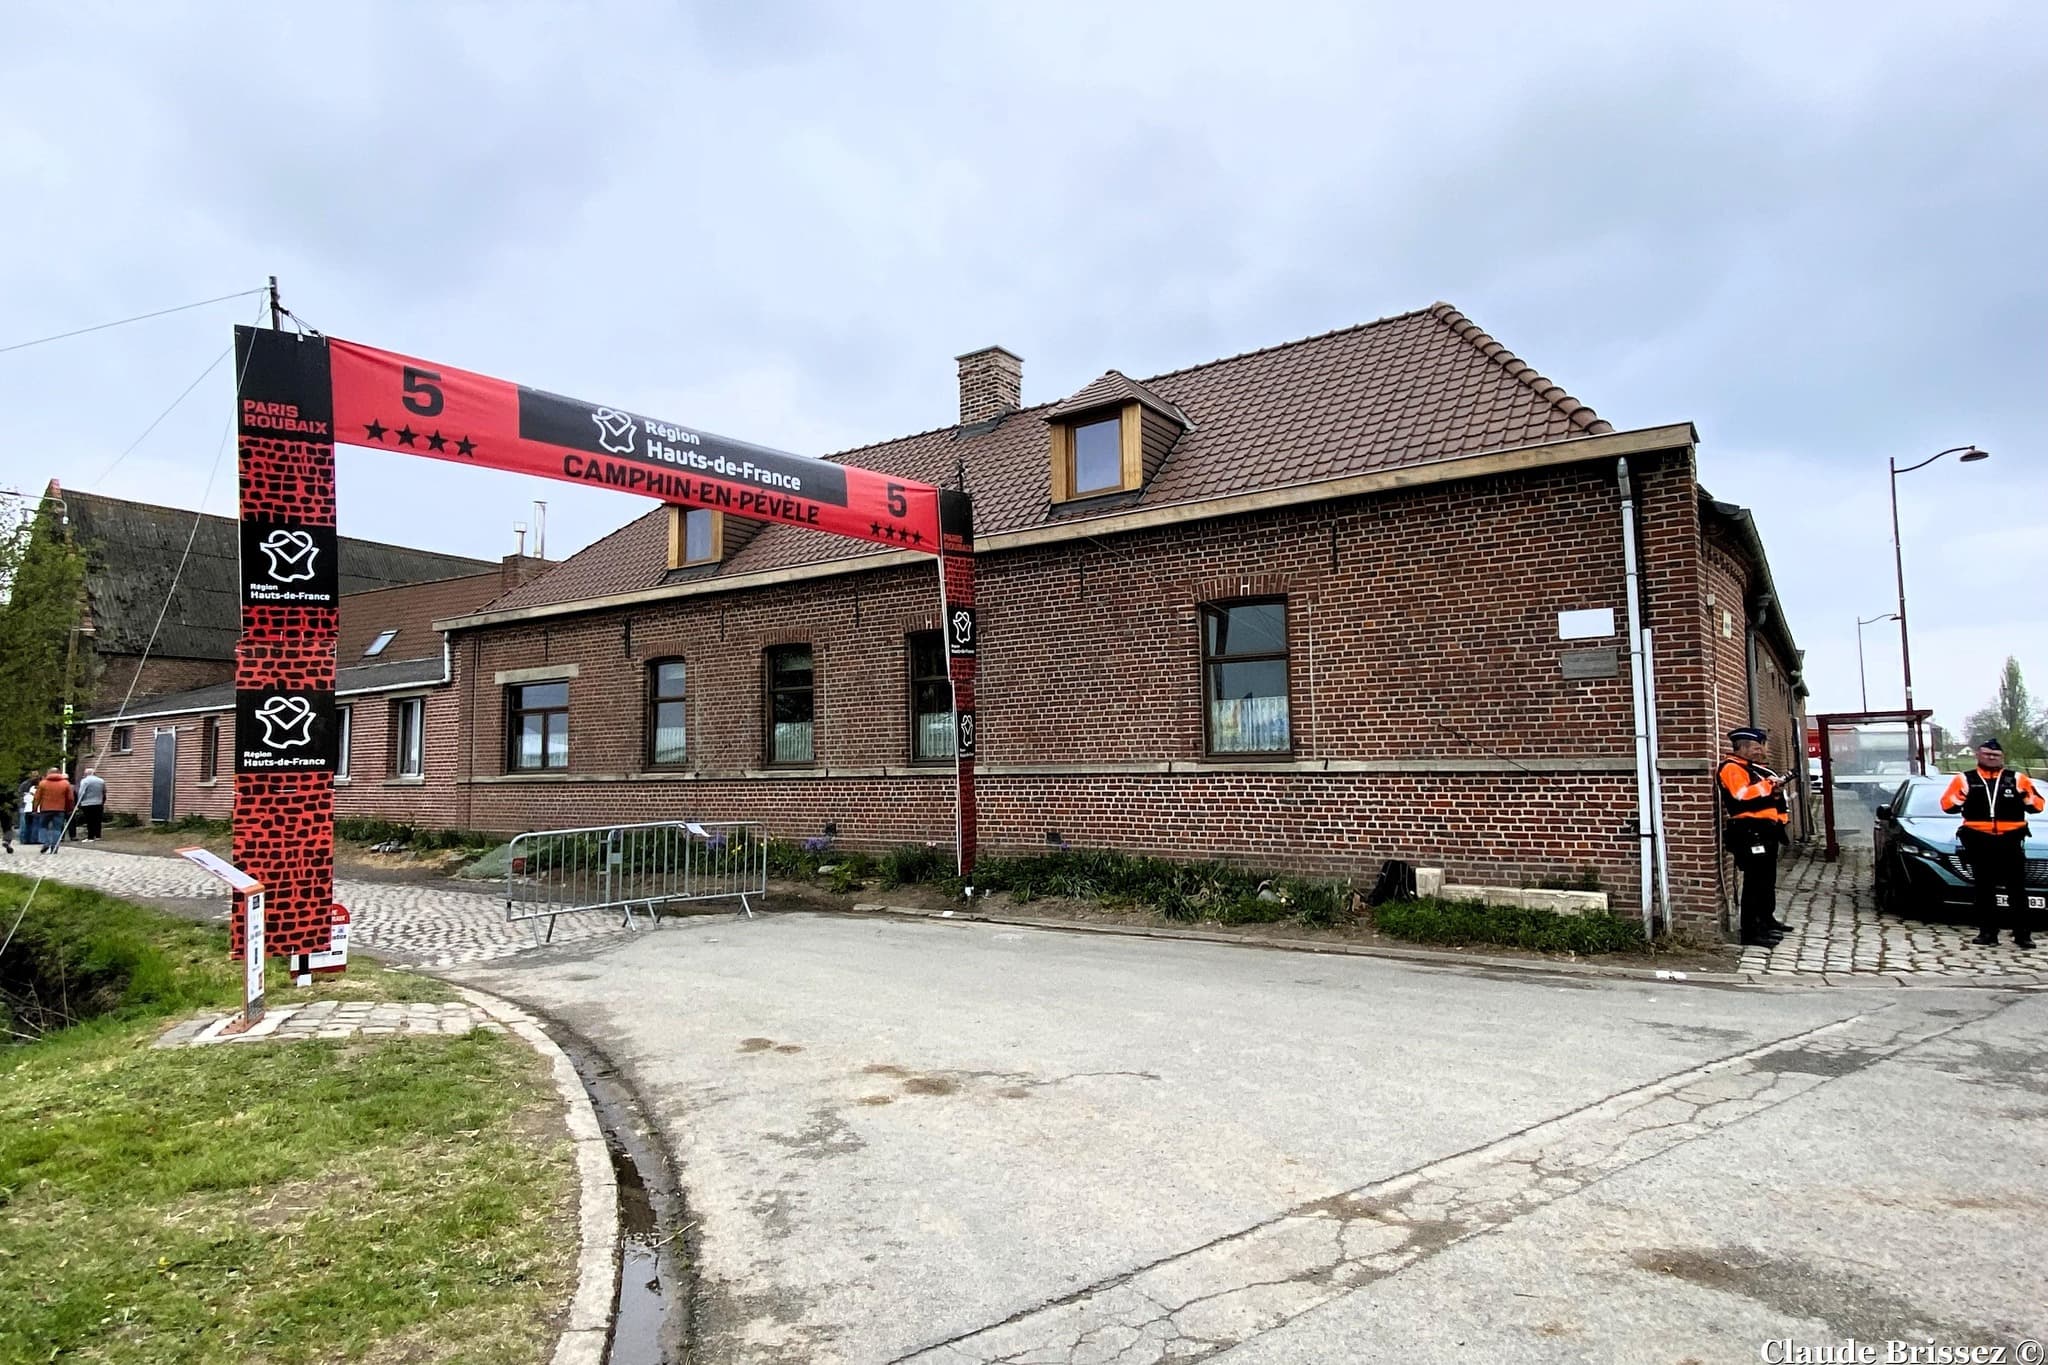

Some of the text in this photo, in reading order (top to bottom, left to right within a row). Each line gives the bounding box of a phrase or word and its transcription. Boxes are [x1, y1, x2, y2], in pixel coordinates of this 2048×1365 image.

[402, 365, 444, 417] 5
[243, 400, 299, 418] PARIS
[244, 413, 328, 435] ROUBAIX
[644, 420, 700, 446] Région
[646, 438, 801, 491] Hauts-de-France
[563, 454, 820, 525] CAMPHIN-EN-PÉVÈLE
[887, 482, 907, 518] 5
[250, 583, 278, 591] Région
[250, 590, 330, 600] Hauts-de-France
[243, 751, 272, 759] Région
[243, 758, 326, 767] Hauts-de-France
